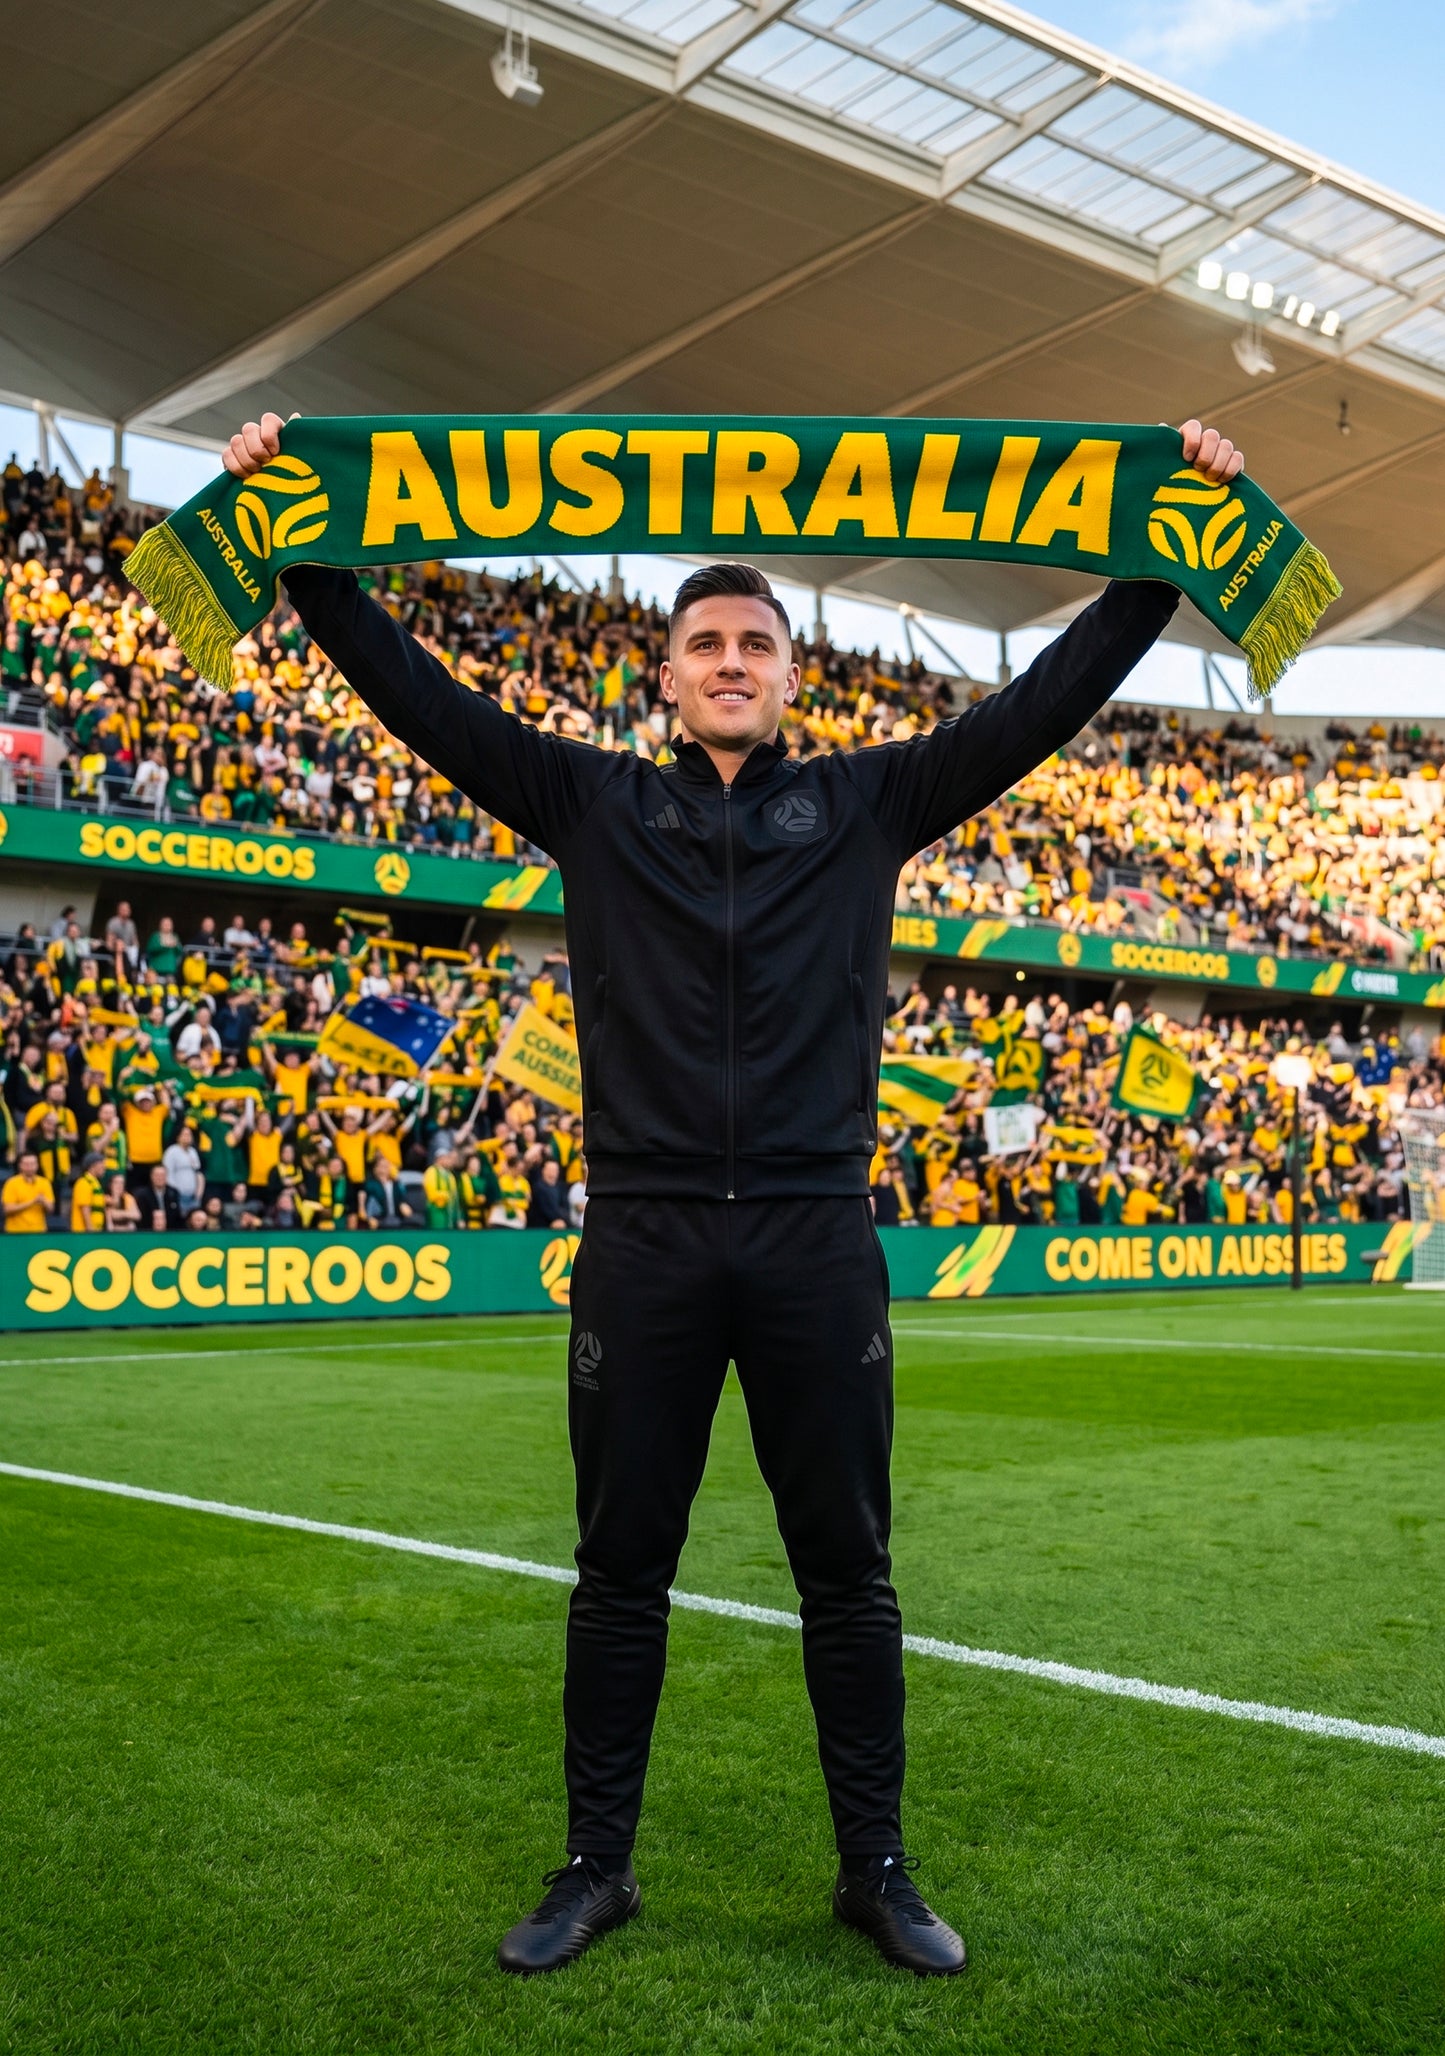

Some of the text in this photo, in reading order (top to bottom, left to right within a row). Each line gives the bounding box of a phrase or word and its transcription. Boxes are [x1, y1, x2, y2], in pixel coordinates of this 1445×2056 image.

[362, 429, 1122, 556] AUSTRALIA
[196, 508, 261, 604] AUSTRALIA
[1219, 520, 1284, 612] AUSTRALIA
[80, 822, 316, 881] SOCCEROOS
[1111, 942, 1229, 979] SOCCEROOS
[26, 1244, 451, 1312] SOCCEROOS
[1045, 1233, 1347, 1281] COME ON AUSSIES
